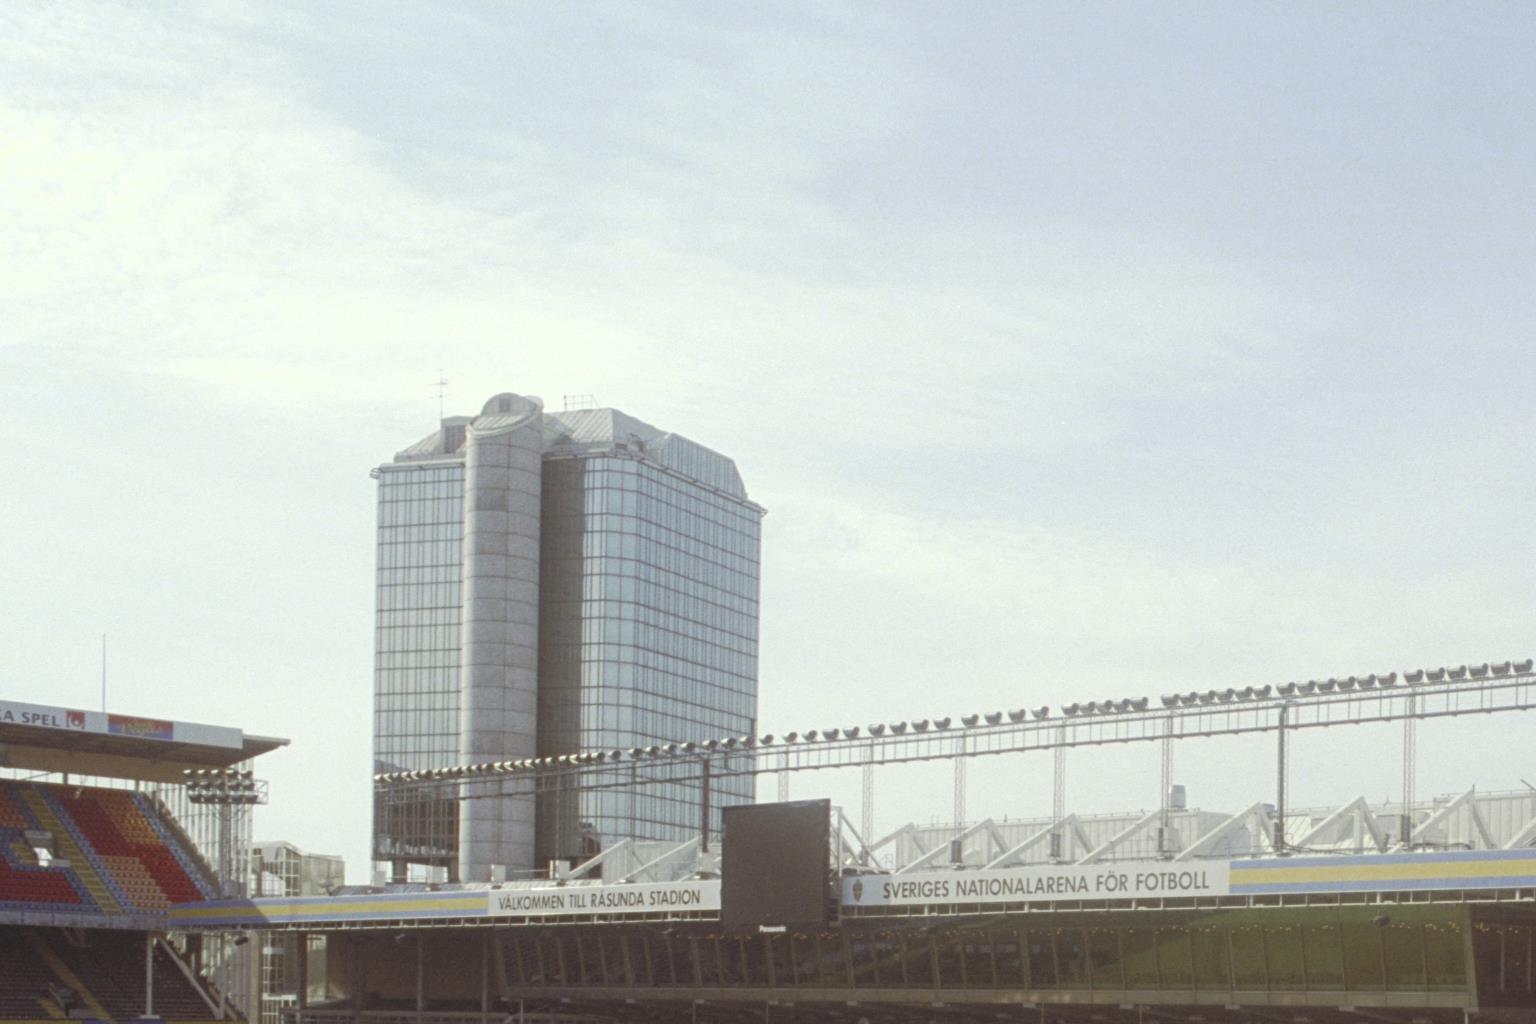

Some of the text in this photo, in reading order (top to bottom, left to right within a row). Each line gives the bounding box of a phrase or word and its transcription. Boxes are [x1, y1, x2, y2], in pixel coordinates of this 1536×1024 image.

[0, 708, 60, 727] A SPEL
[882, 870, 1210, 899] SVERIGES NATIONALARENA FÖR FOTBOLL
[498, 889, 701, 911] VÄLKOMMEN TILL RÅSUNDA STADION
